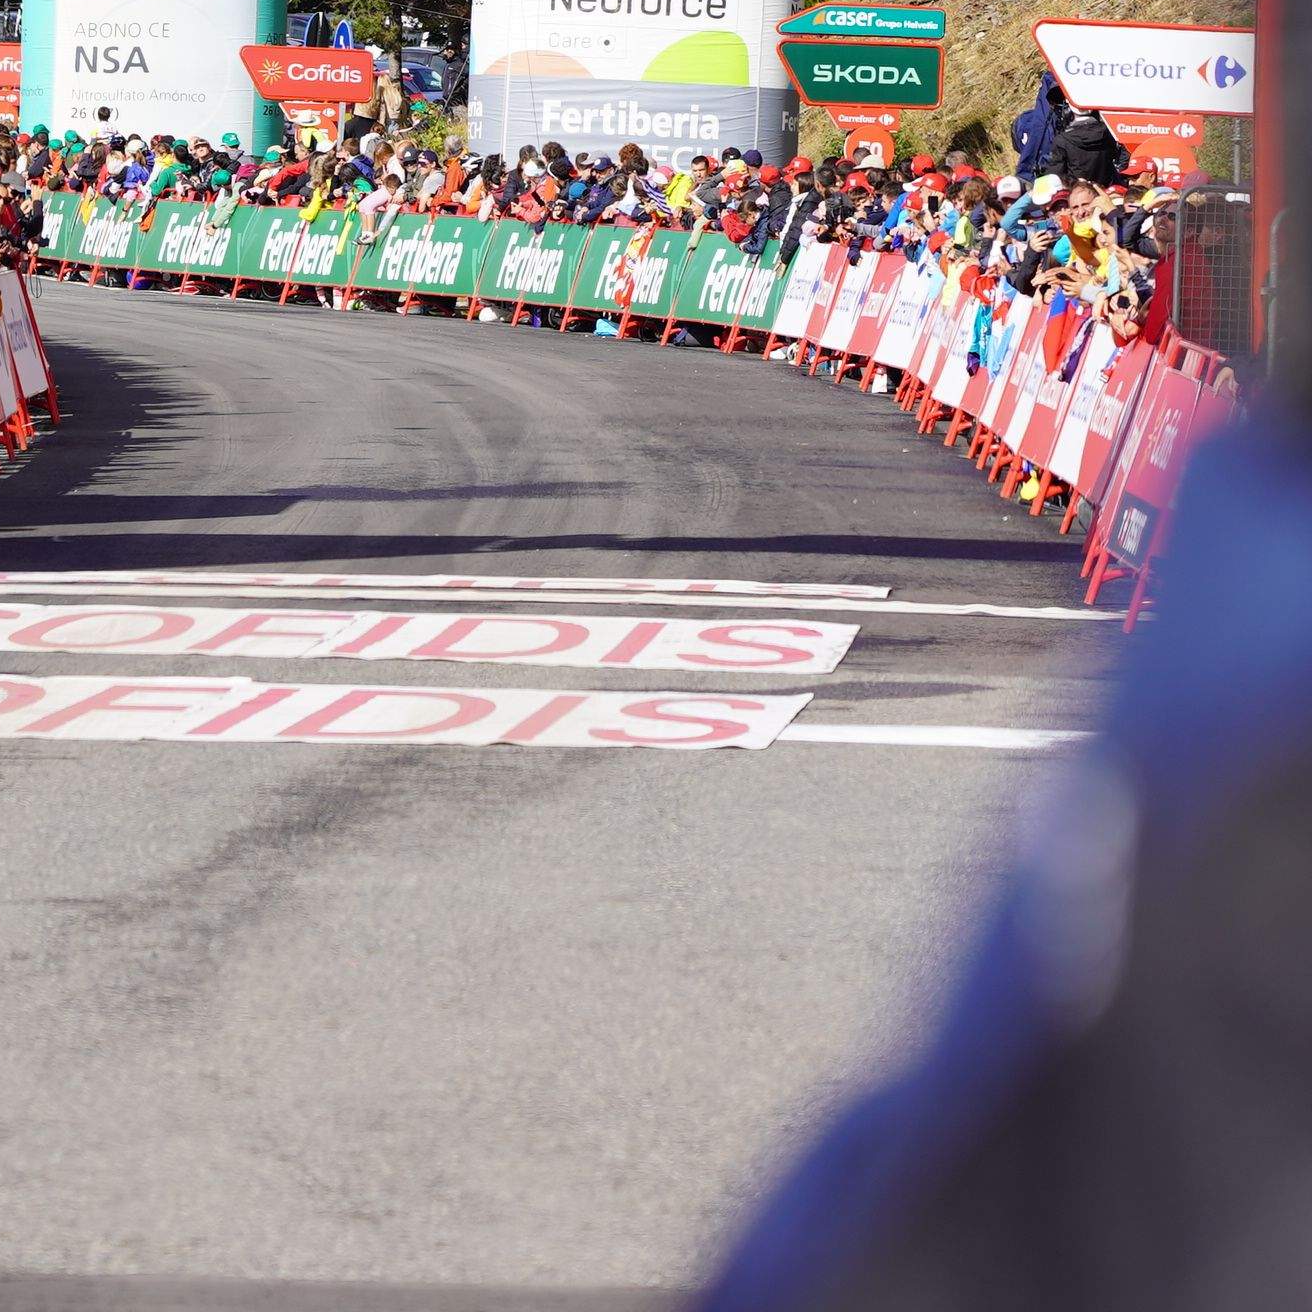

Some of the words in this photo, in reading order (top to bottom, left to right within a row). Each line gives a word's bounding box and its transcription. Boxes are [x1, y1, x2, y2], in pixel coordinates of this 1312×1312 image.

[74, 21, 141, 39] ABONO
[147, 21, 170, 38] CE
[825, 10, 877, 27] caser
[875, 19, 902, 30] Grupo
[548, 32, 592, 49] Care
[74, 45, 149, 74] NSA
[1065, 55, 1186, 80] Carrefour
[287, 63, 362, 83] Cofidis
[71, 89, 145, 102] Nitrosulfato
[71, 107, 87, 119] 26
[541, 98, 720, 141] Fertiberia
[1117, 123, 1170, 135] Carrefour
[376, 224, 464, 286] Fertiberia
[495, 231, 565, 295] Fertiberia
